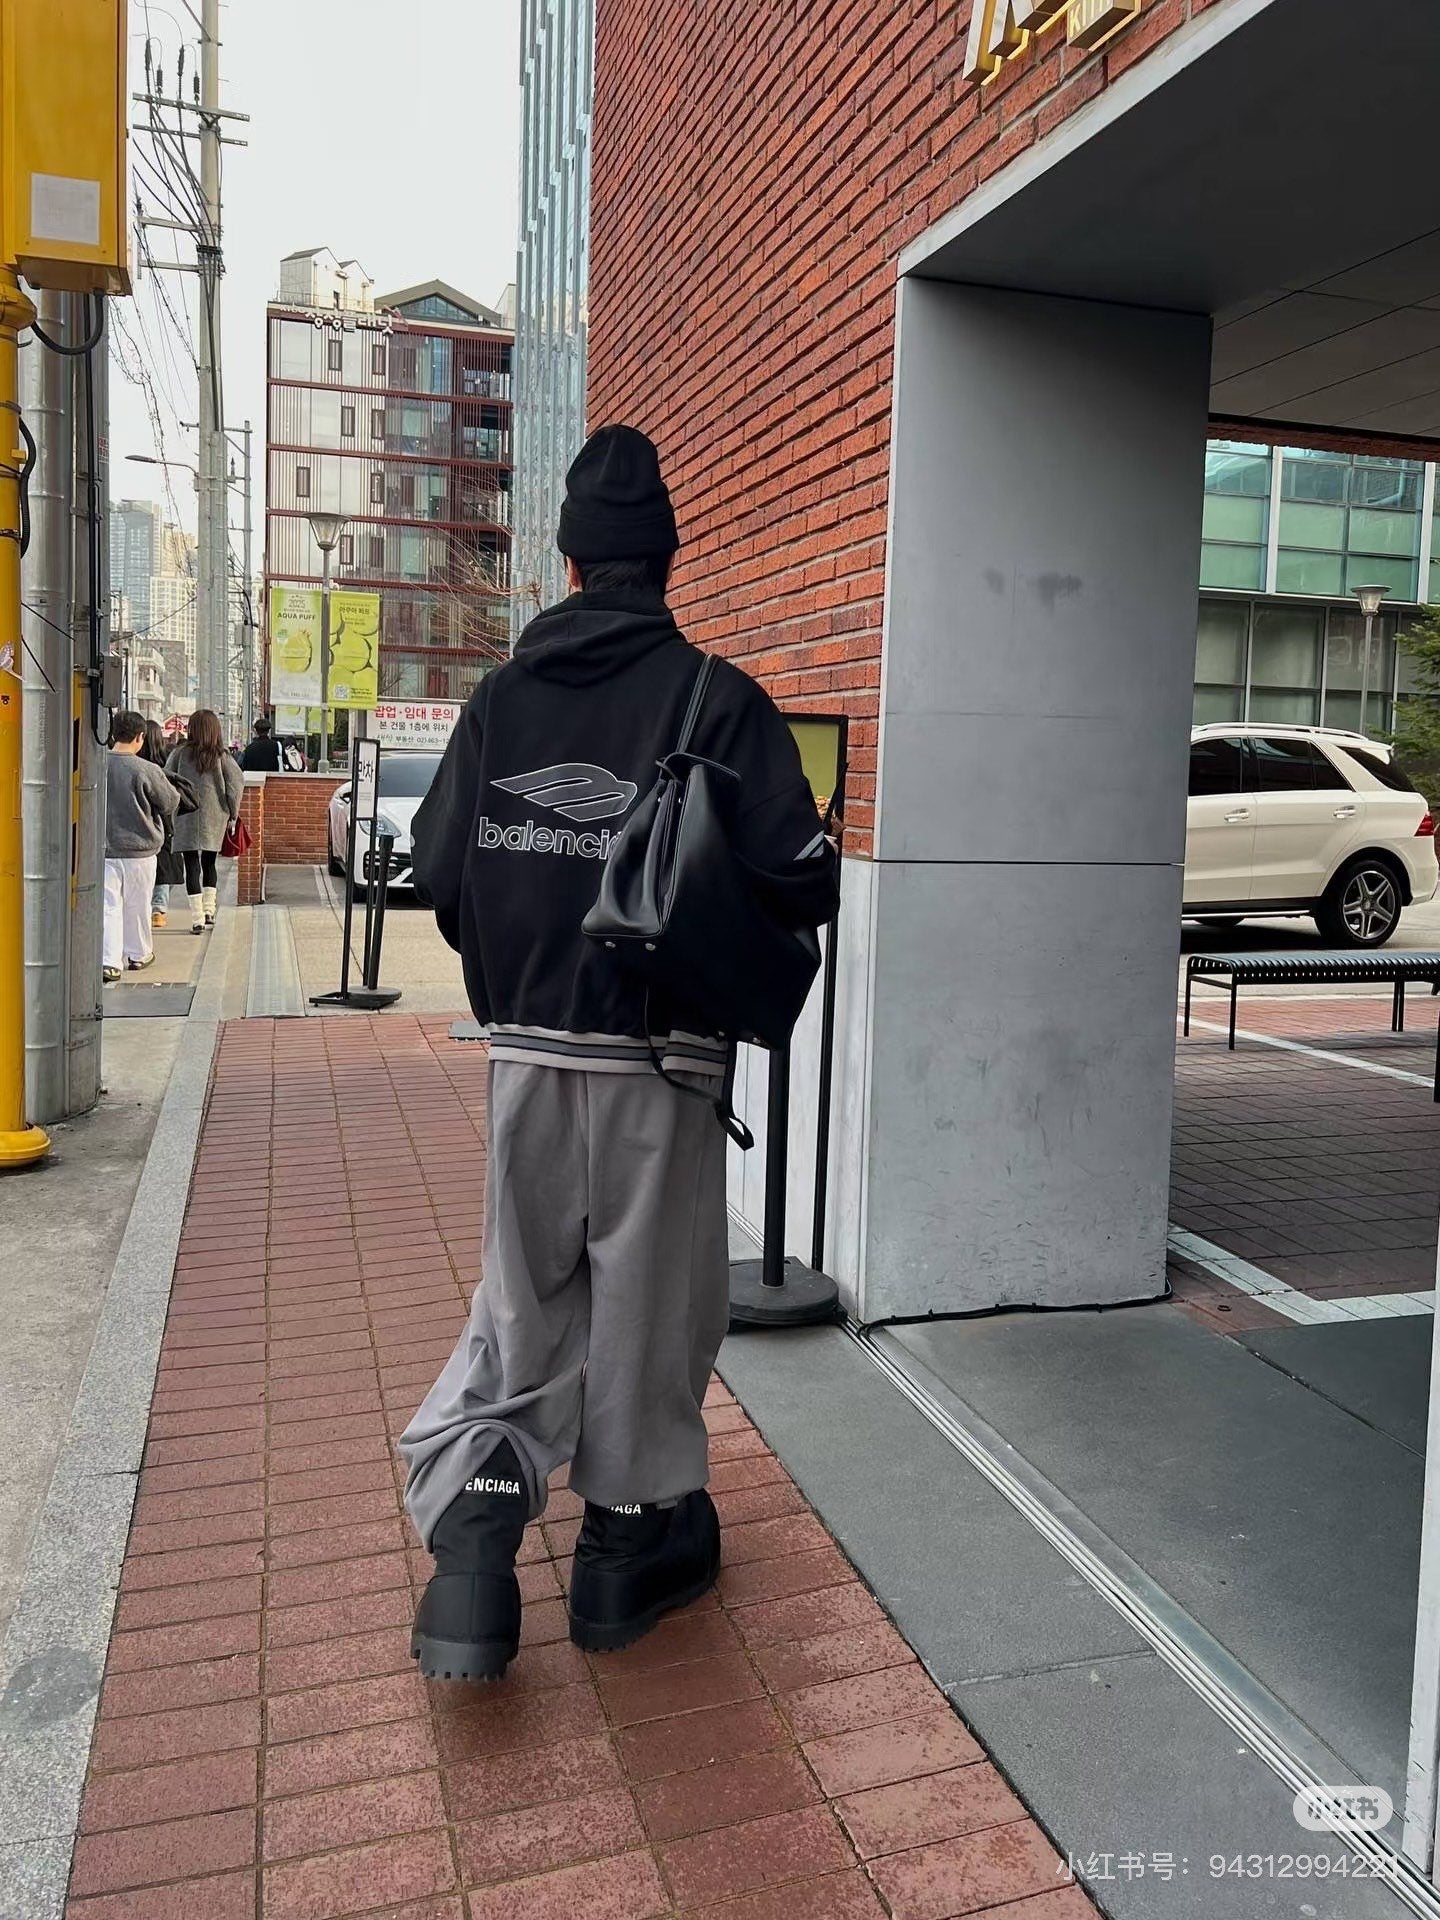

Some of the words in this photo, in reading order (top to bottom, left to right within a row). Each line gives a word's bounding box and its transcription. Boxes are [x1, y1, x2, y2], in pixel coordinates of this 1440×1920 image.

[299, 613, 316, 621] PUFF
[432, 707, 453, 721] 문의
[379, 721, 387, 730] 본
[390, 721, 405, 731] 건물
[409, 722, 430, 731] 1층에
[433, 723, 448, 732] 위치
